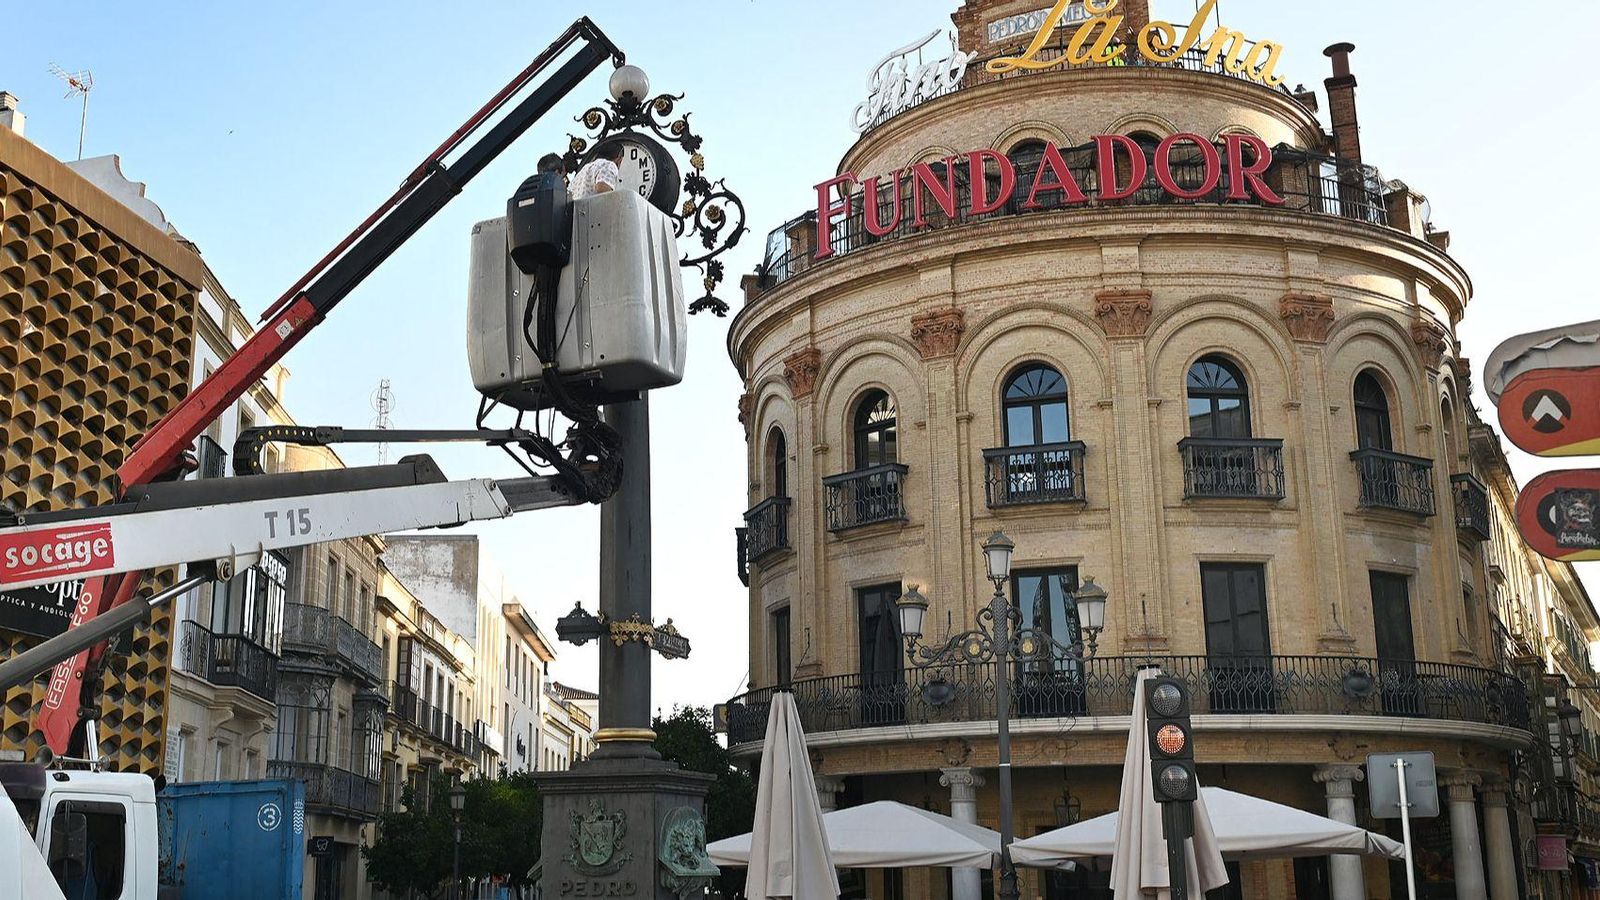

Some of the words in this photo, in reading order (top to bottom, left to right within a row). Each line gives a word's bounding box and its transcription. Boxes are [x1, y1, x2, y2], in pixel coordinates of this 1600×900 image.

[989, 14, 1038, 41] PEDRO
[851, 28, 979, 134] Fino
[813, 131, 1286, 260] FUNDADOR
[264, 511, 278, 539] T
[286, 507, 312, 537] 15
[5, 536, 109, 570] socage
[262, 807, 277, 828] 3
[559, 878, 638, 898] PEDRO
